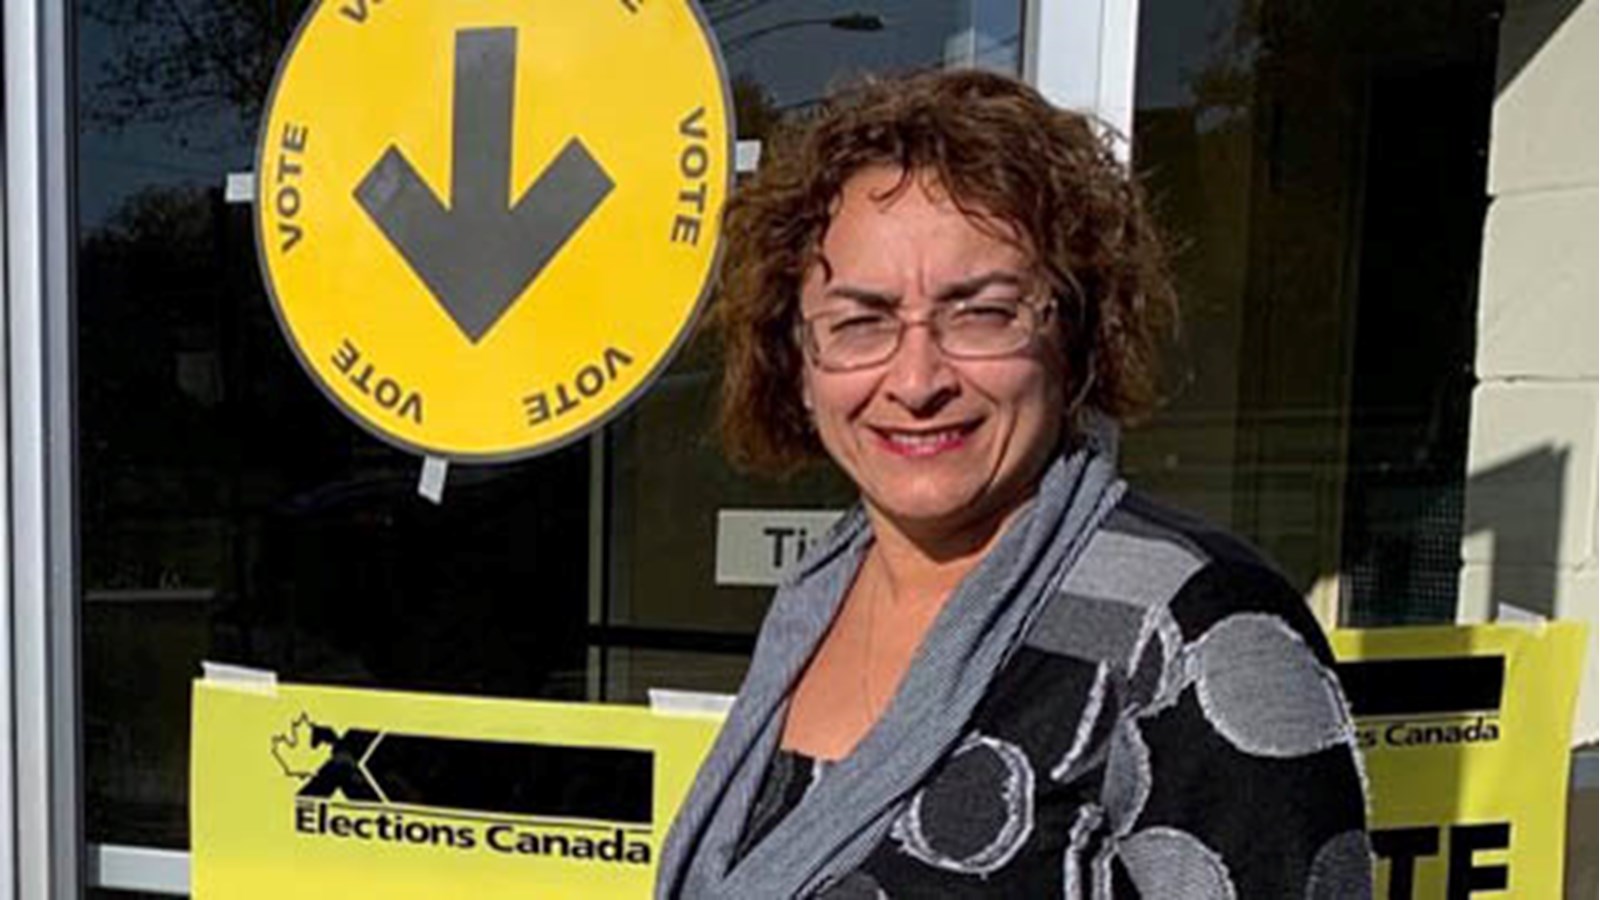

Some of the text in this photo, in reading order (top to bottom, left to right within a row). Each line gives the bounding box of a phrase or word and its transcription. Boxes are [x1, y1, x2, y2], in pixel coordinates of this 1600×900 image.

[277, 122, 308, 253] VOTE
[670, 106, 709, 247] VOTE
[330, 339, 424, 425] VOTE
[522, 346, 634, 426] VOTE
[763, 527, 818, 567] Ti
[1384, 716, 1500, 747] Canada
[295, 802, 652, 864] Elections Canada
[1369, 822, 1511, 900] TE
